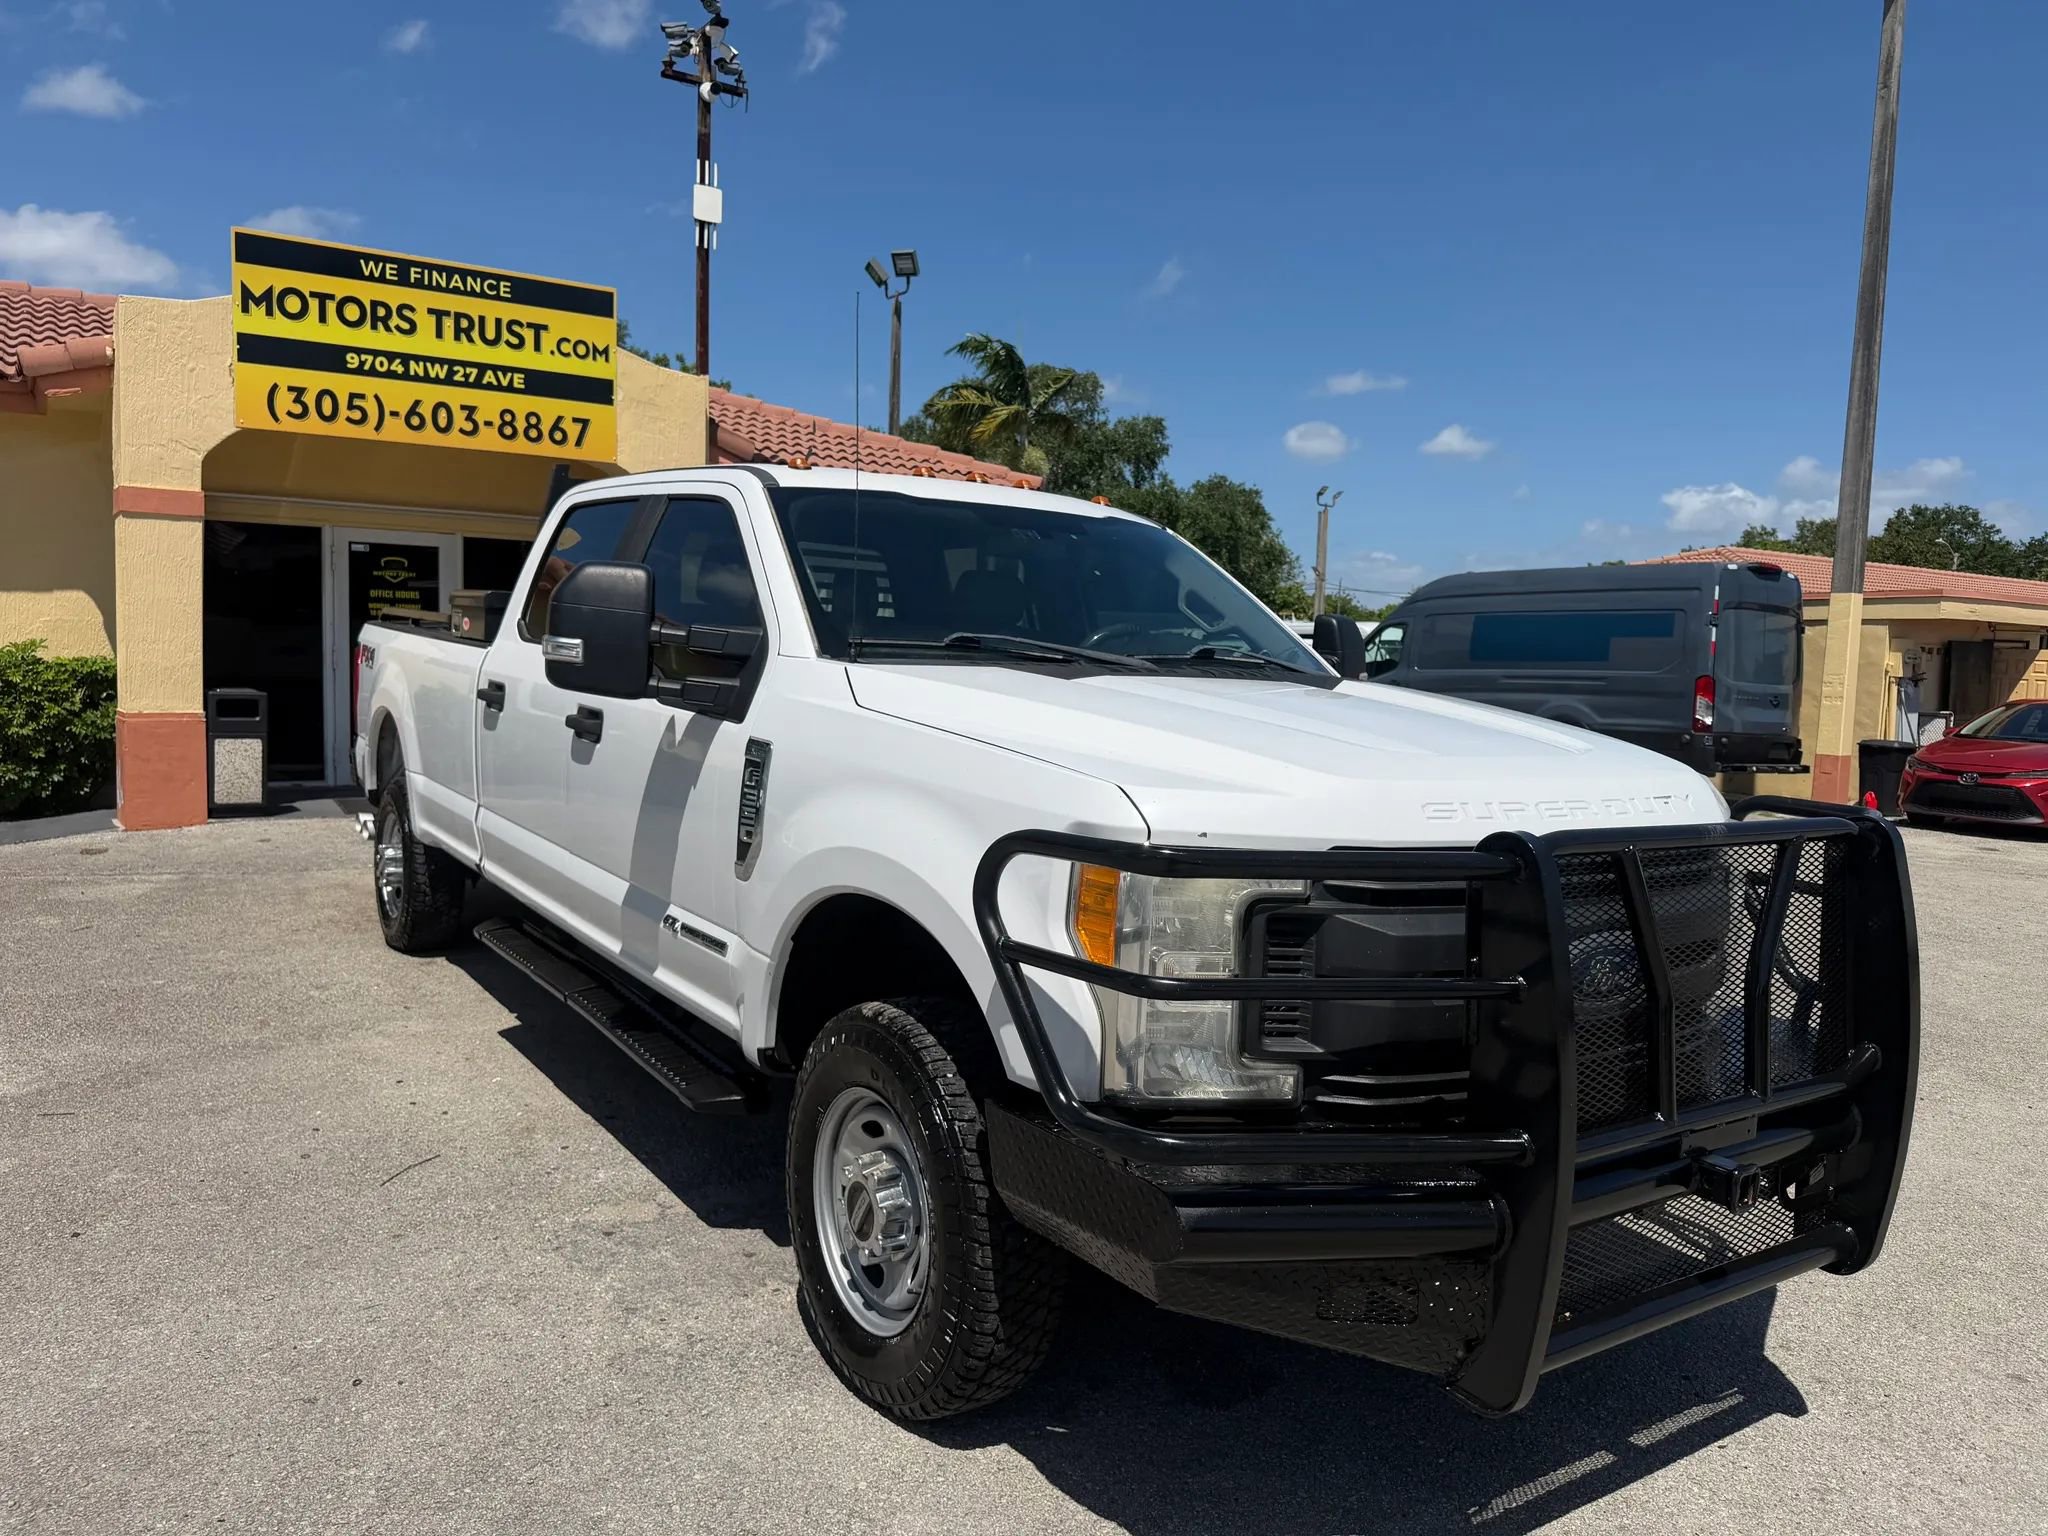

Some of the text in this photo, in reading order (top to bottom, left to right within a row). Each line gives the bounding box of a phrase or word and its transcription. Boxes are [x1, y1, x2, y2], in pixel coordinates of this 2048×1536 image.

[360, 259, 512, 298] WE FINANCE
[240, 280, 417, 337] MOTORS
[345, 352, 525, 389] 9704 NW 27 AVE
[267, 382, 591, 448] (305)-603-8867
